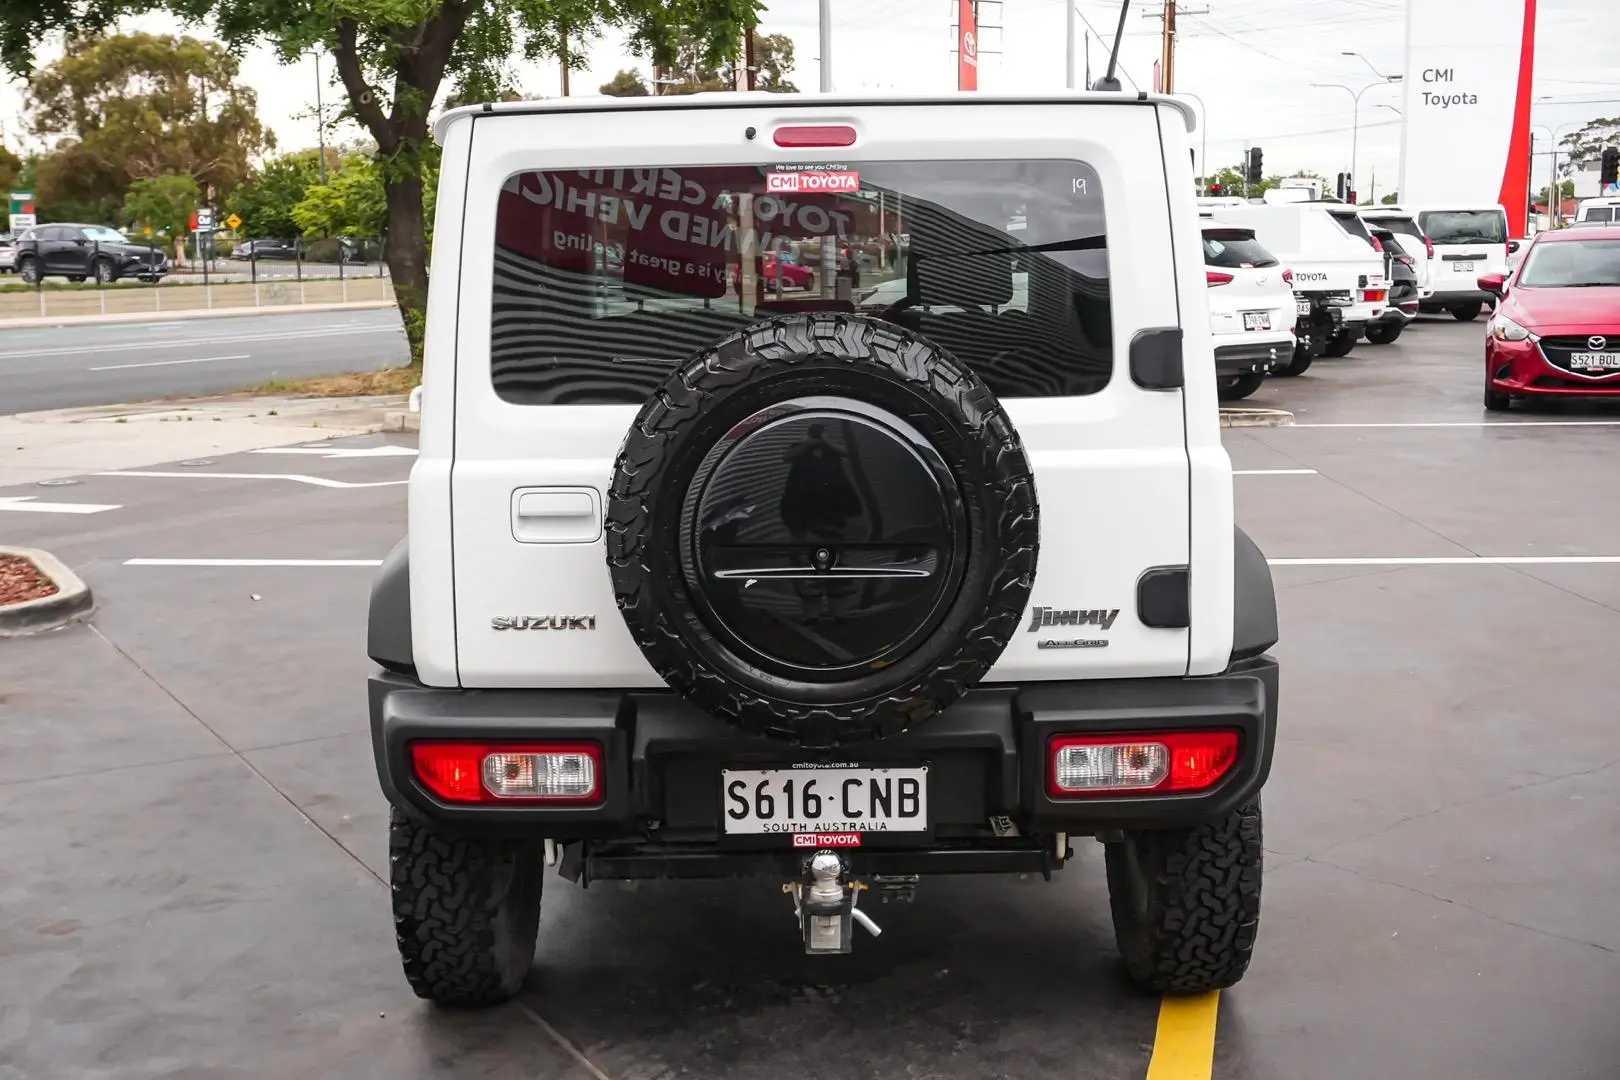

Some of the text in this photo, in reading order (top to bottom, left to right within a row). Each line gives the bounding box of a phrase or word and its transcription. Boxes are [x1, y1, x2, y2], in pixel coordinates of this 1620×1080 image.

[1422, 68, 1454, 82] CMI
[1421, 92, 1478, 109] Toyota
[770, 175, 857, 189] CMI TOYOTA
[1295, 273, 1328, 281] TOYOTA
[491, 615, 596, 631] SUZUKI
[1027, 606, 1120, 633] Jimny
[763, 821, 888, 833] SOUTH AUSTRALIA
[795, 834, 860, 845] CMI TOYOTA
